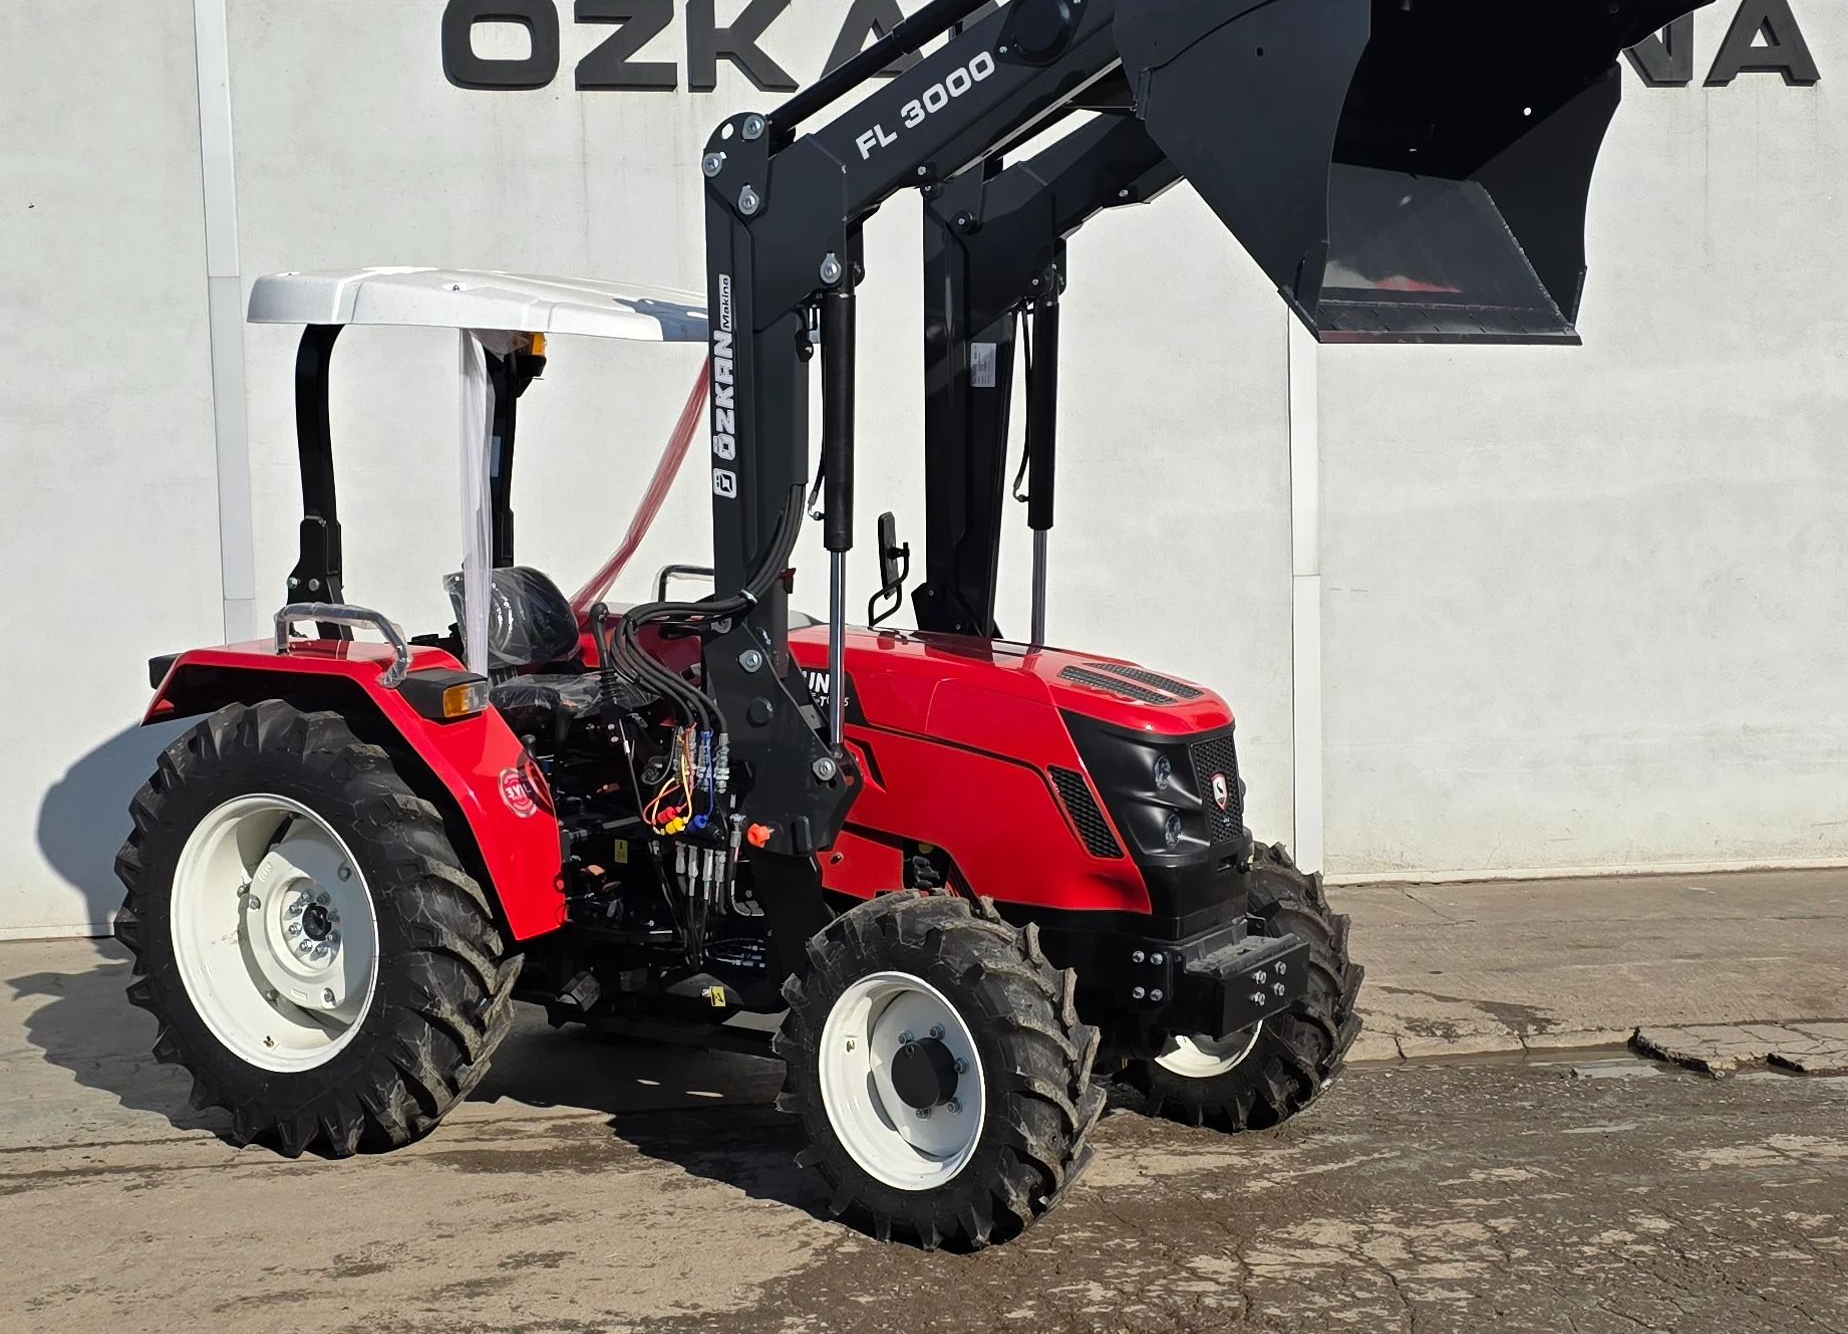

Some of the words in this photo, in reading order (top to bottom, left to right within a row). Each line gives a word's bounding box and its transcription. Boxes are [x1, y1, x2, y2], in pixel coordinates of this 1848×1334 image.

[855, 123, 898, 161] FL
[900, 50, 996, 129] 3000
[721, 277, 730, 330] Makina
[712, 329, 737, 462] ÖZKAN
